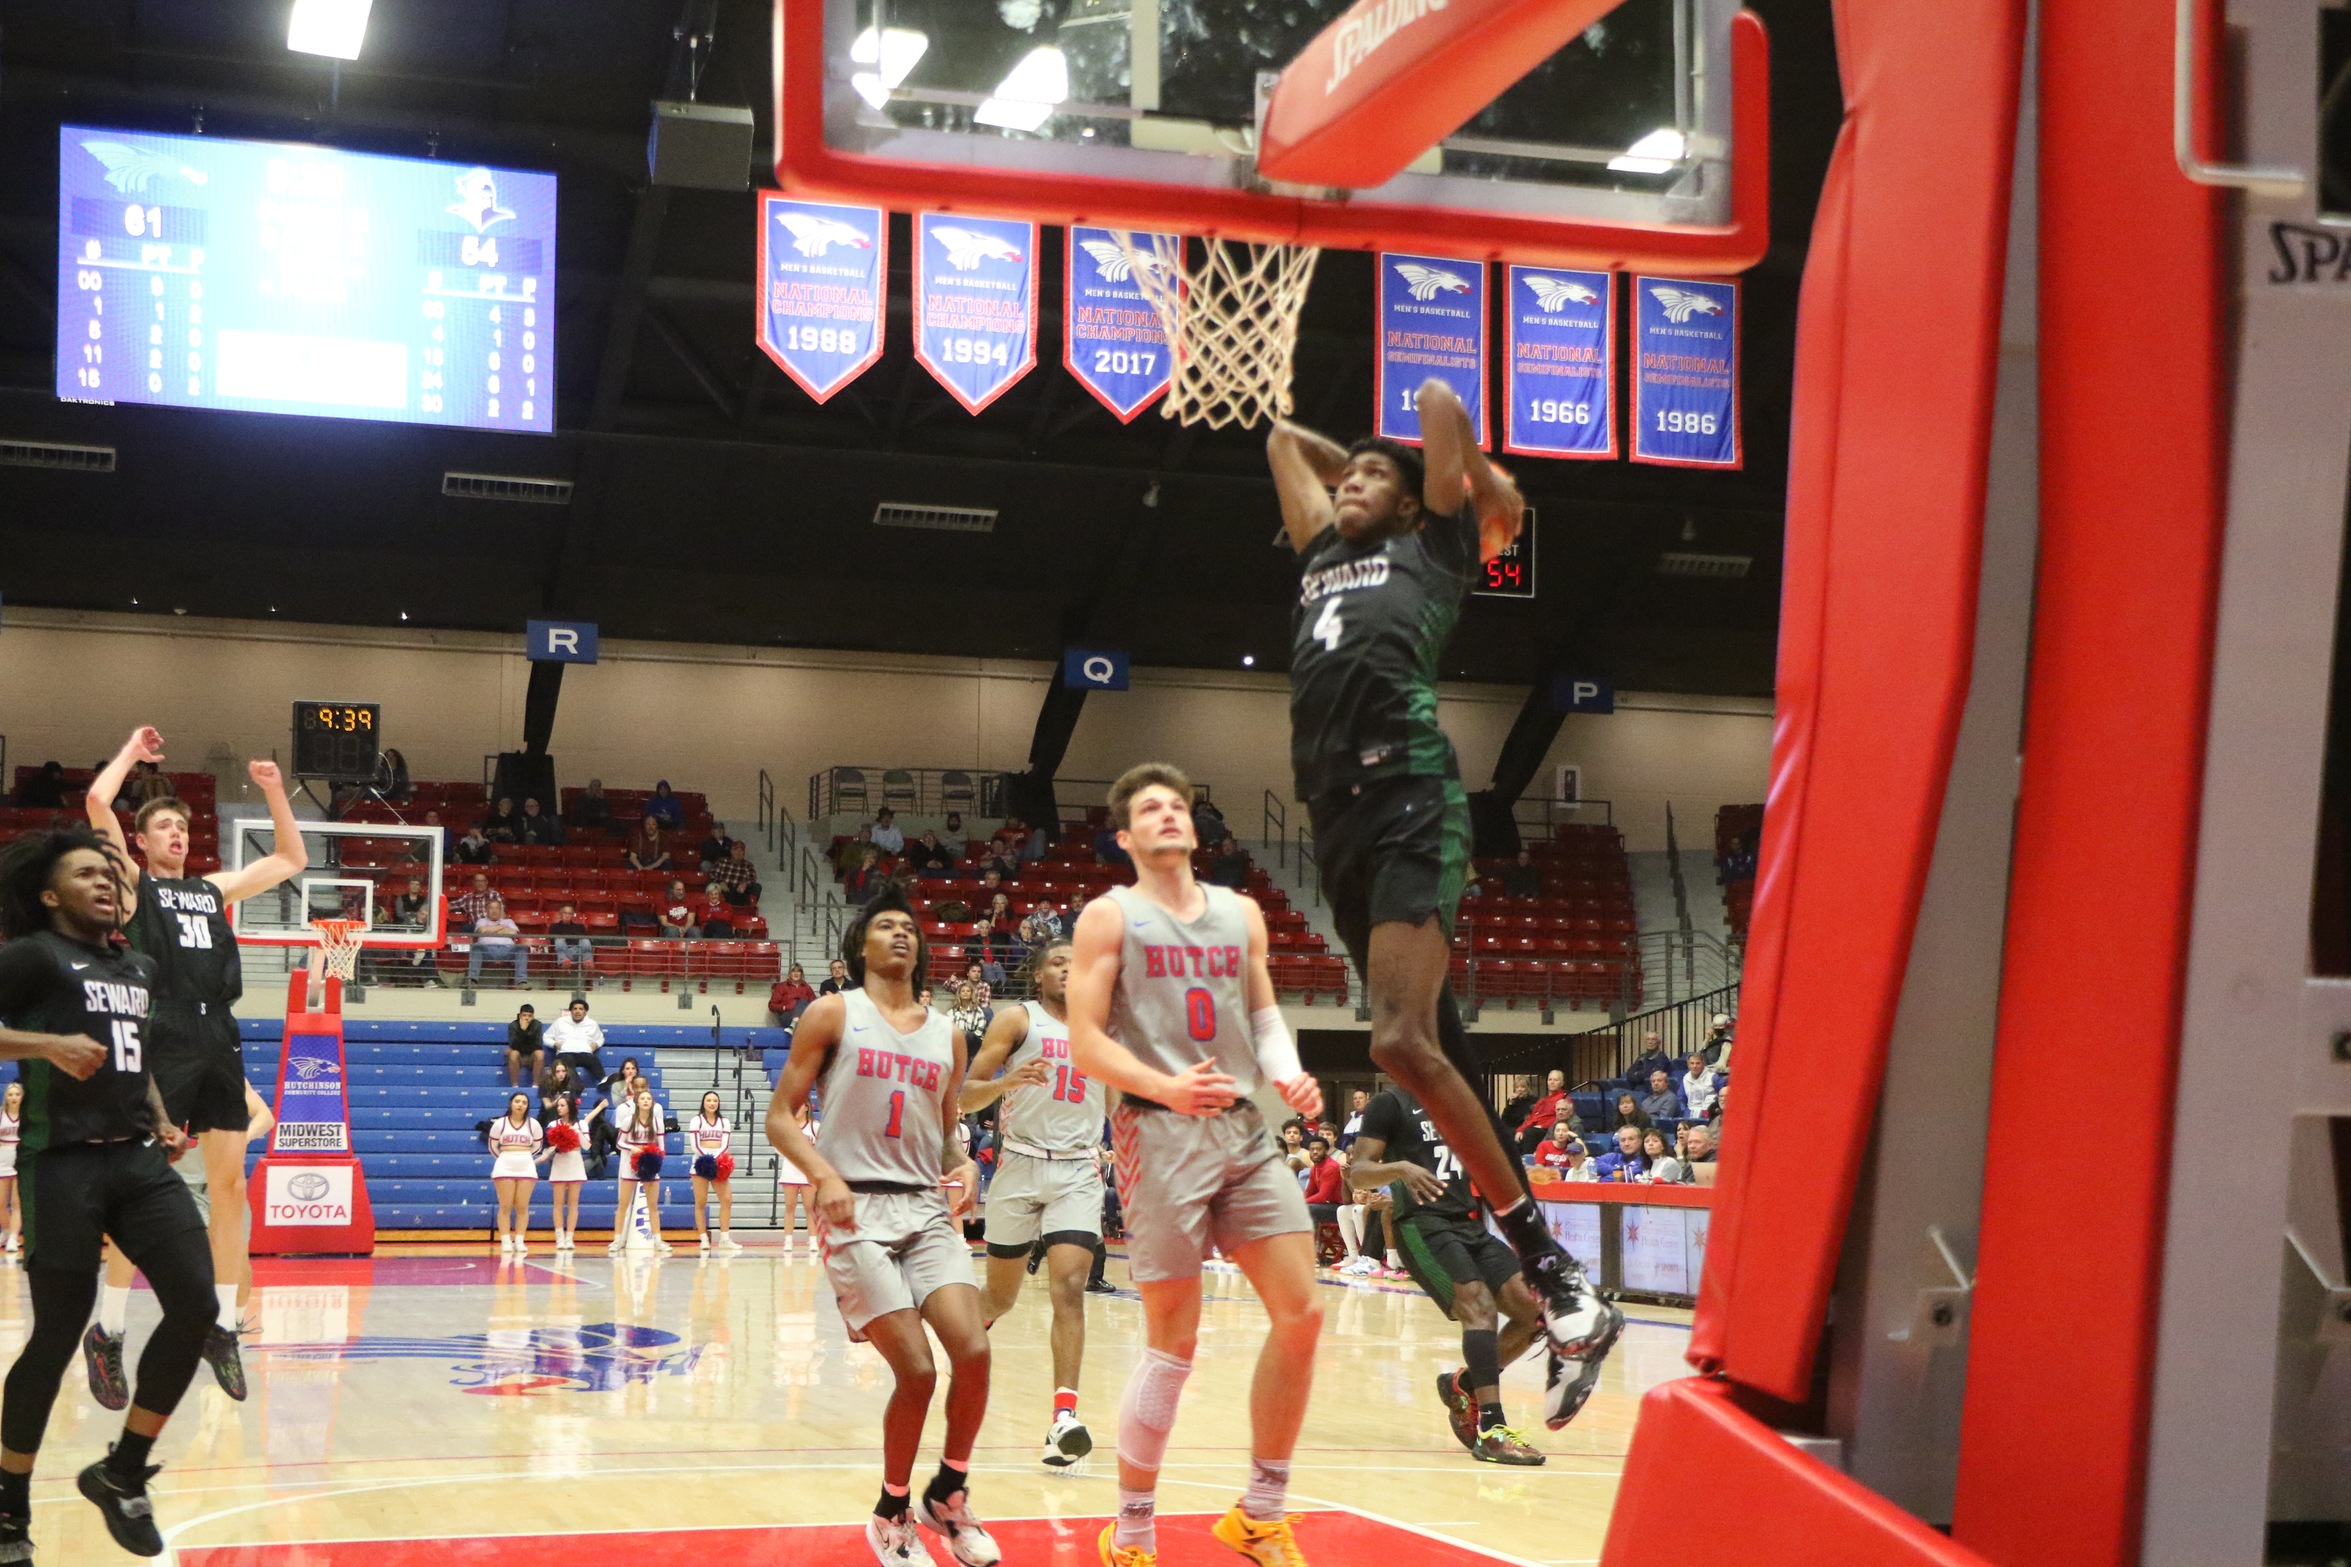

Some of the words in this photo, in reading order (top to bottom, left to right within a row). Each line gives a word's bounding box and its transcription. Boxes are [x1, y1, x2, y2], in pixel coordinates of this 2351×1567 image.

[125, 204, 162, 238] 61
[781, 263, 807, 273] MEN'S
[810, 265, 865, 278] BASKETBALL
[773, 281, 873, 306] NATIONAL
[935, 276, 961, 286] MEN'S
[963, 278, 1017, 291] BASKETBALL
[1085, 289, 1110, 298] MEN'S
[94, 296, 102, 315] 1
[155, 301, 164, 320] 1
[772, 300, 874, 322] CHAMPIONS
[928, 294, 1024, 318] NATIONAL
[1077, 307, 1161, 328] NATIONA
[1394, 304, 1418, 313] MEN'S
[1420, 306, 1471, 319] BASKETBALL
[927, 312, 1026, 334] CHAMPIONS
[1523, 316, 1546, 325] MEN'S
[1548, 317, 1599, 328] BASKETBALL
[1649, 327, 1672, 335] MEN'S
[1674, 328, 1722, 340] BASKETBALL
[493, 329, 501, 347] 1
[788, 326, 856, 354] 1988
[1387, 331, 1476, 354] NATIONAL
[84, 344, 102, 364] 11
[942, 338, 1008, 366] 1994
[1095, 350, 1156, 376] 2017
[1517, 343, 1602, 363] NATIONAL
[1643, 353, 1730, 374] NATIONAL
[527, 378, 535, 396] 1
[60, 397, 115, 407] DAKTRONICS
[1531, 400, 1589, 425] 1966
[1657, 411, 1716, 435] 1986
[1487, 559, 1521, 587] 54
[1313, 595, 1343, 651] 4
[548, 628, 578, 654] R
[1083, 656, 1113, 685] Q
[1573, 682, 1598, 704] P
[319, 707, 372, 731] 9:39
[157, 887, 217, 914] SEWARD
[176, 912, 213, 949] 30
[1144, 945, 1241, 979] HUTCH
[83, 979, 149, 1019] SEWARD
[200, 1002, 206, 1015] S
[1185, 986, 1216, 1042] 0
[111, 1019, 142, 1074] 15
[856, 1047, 941, 1092] HUTCH
[284, 1081, 341, 1090] HUTCHINSON
[1053, 1065, 1087, 1103] 15
[885, 1090, 905, 1138] 1
[279, 1138, 342, 1147] SUPERSTORE
[502, 1134, 530, 1144] HUTCH
[271, 1204, 347, 1219] TOYOTA
